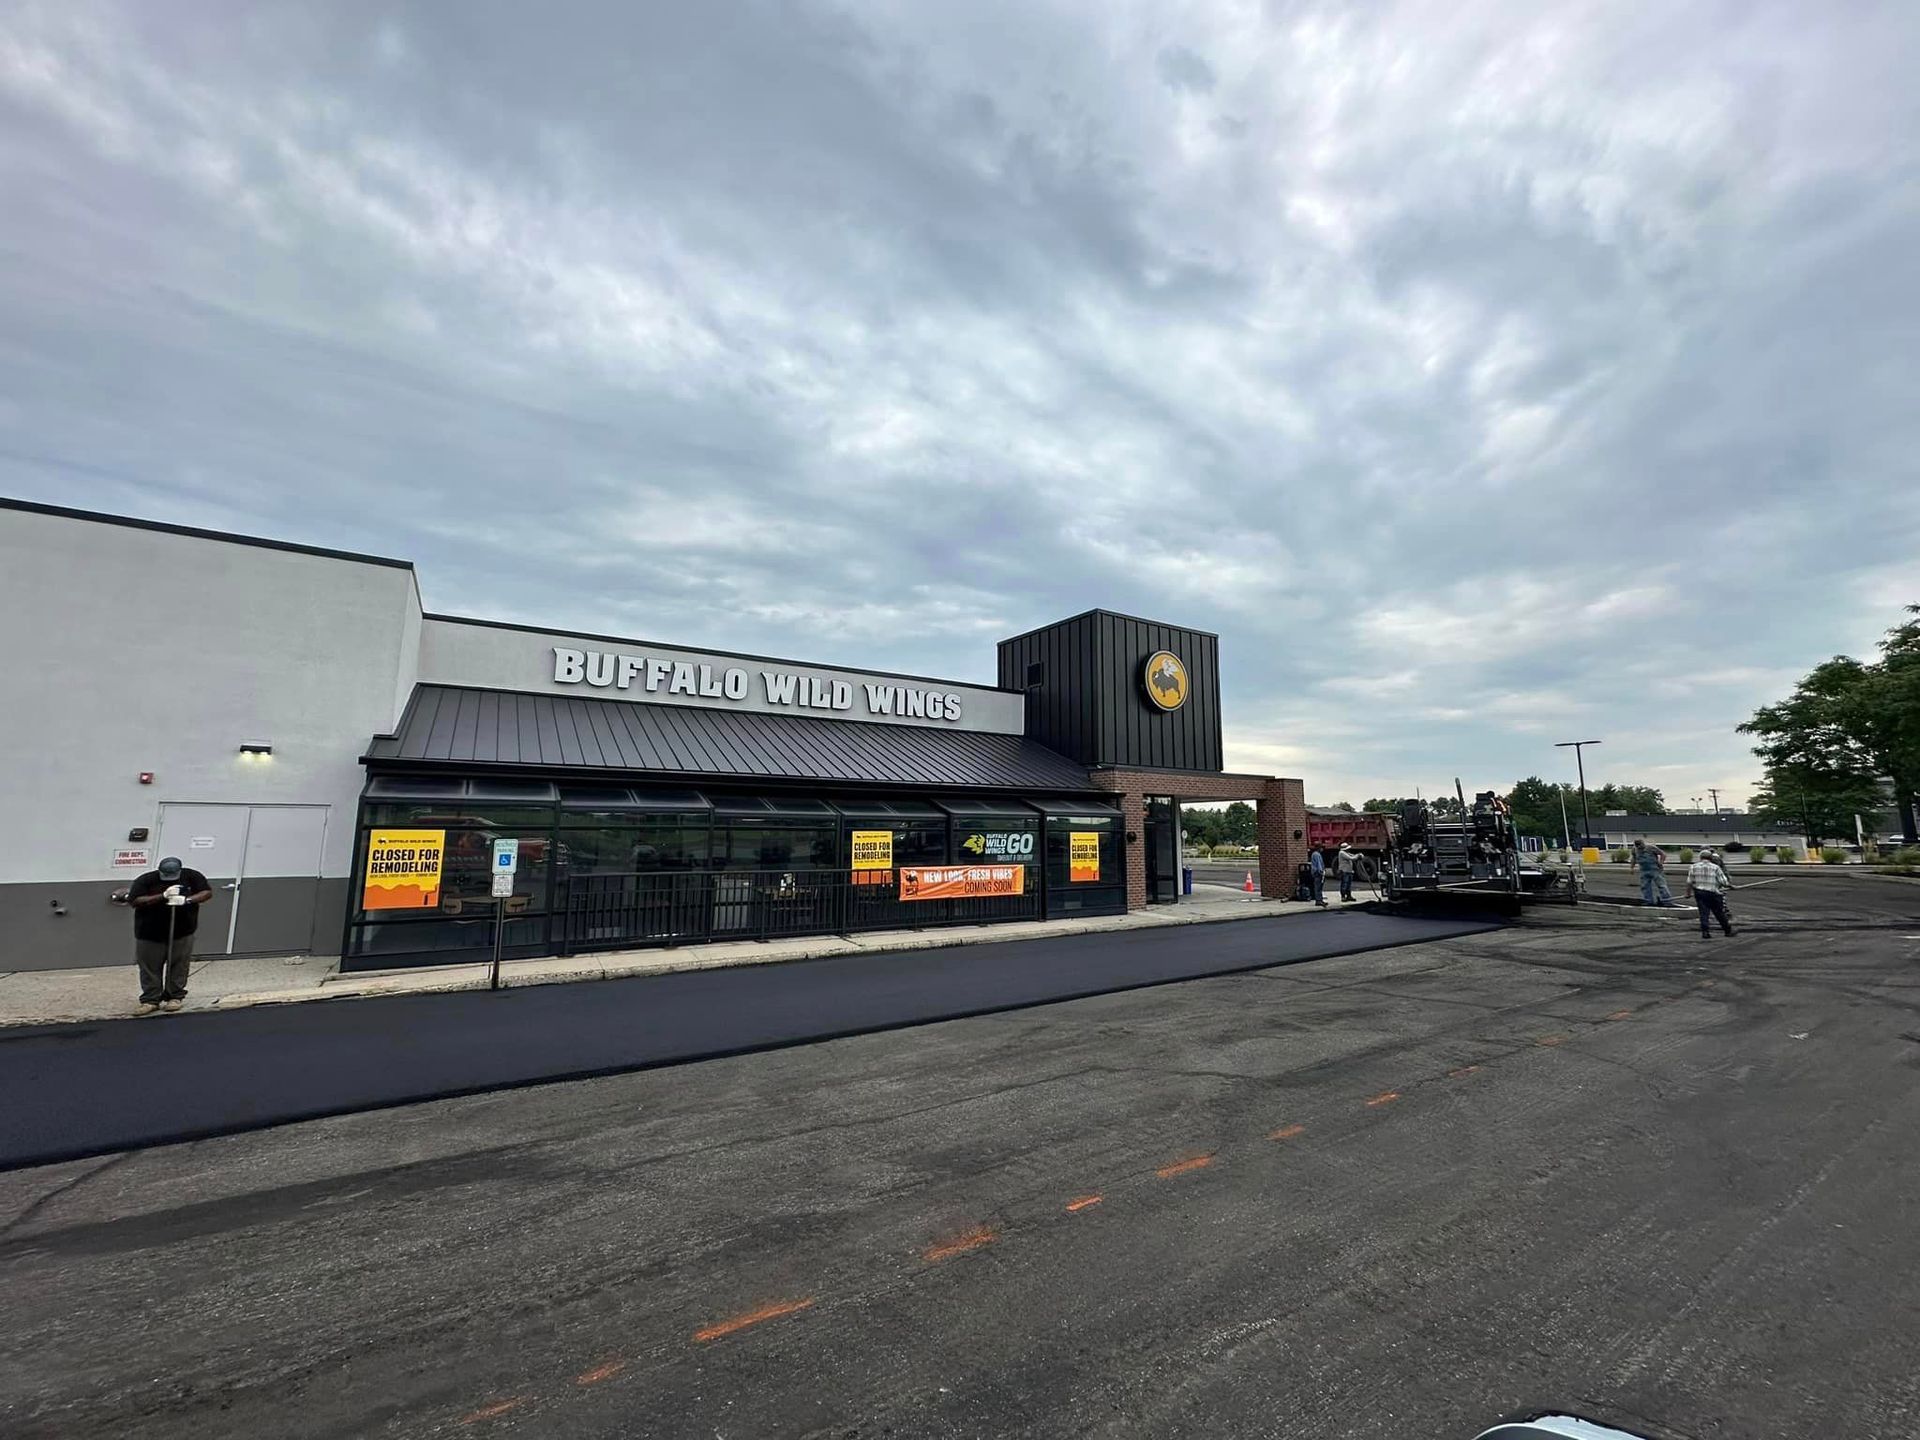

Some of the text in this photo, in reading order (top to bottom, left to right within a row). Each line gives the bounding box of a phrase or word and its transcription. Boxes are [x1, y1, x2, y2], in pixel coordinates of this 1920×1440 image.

[553, 647, 962, 721] BUFFALO WILD WINGS
[854, 842, 890, 851] CLOSED FOR
[986, 838, 1006, 847] WILD
[1007, 833, 1033, 854] GO
[372, 849, 439, 861] CLOSED FOR
[854, 851, 890, 860] REMODELING
[370, 861, 438, 873] REMODELING
[923, 871, 941, 883] NEW
[968, 869, 990, 881] FRESH
[992, 868, 1013, 880] VIBES
[965, 880, 1012, 893] COMING SOON
